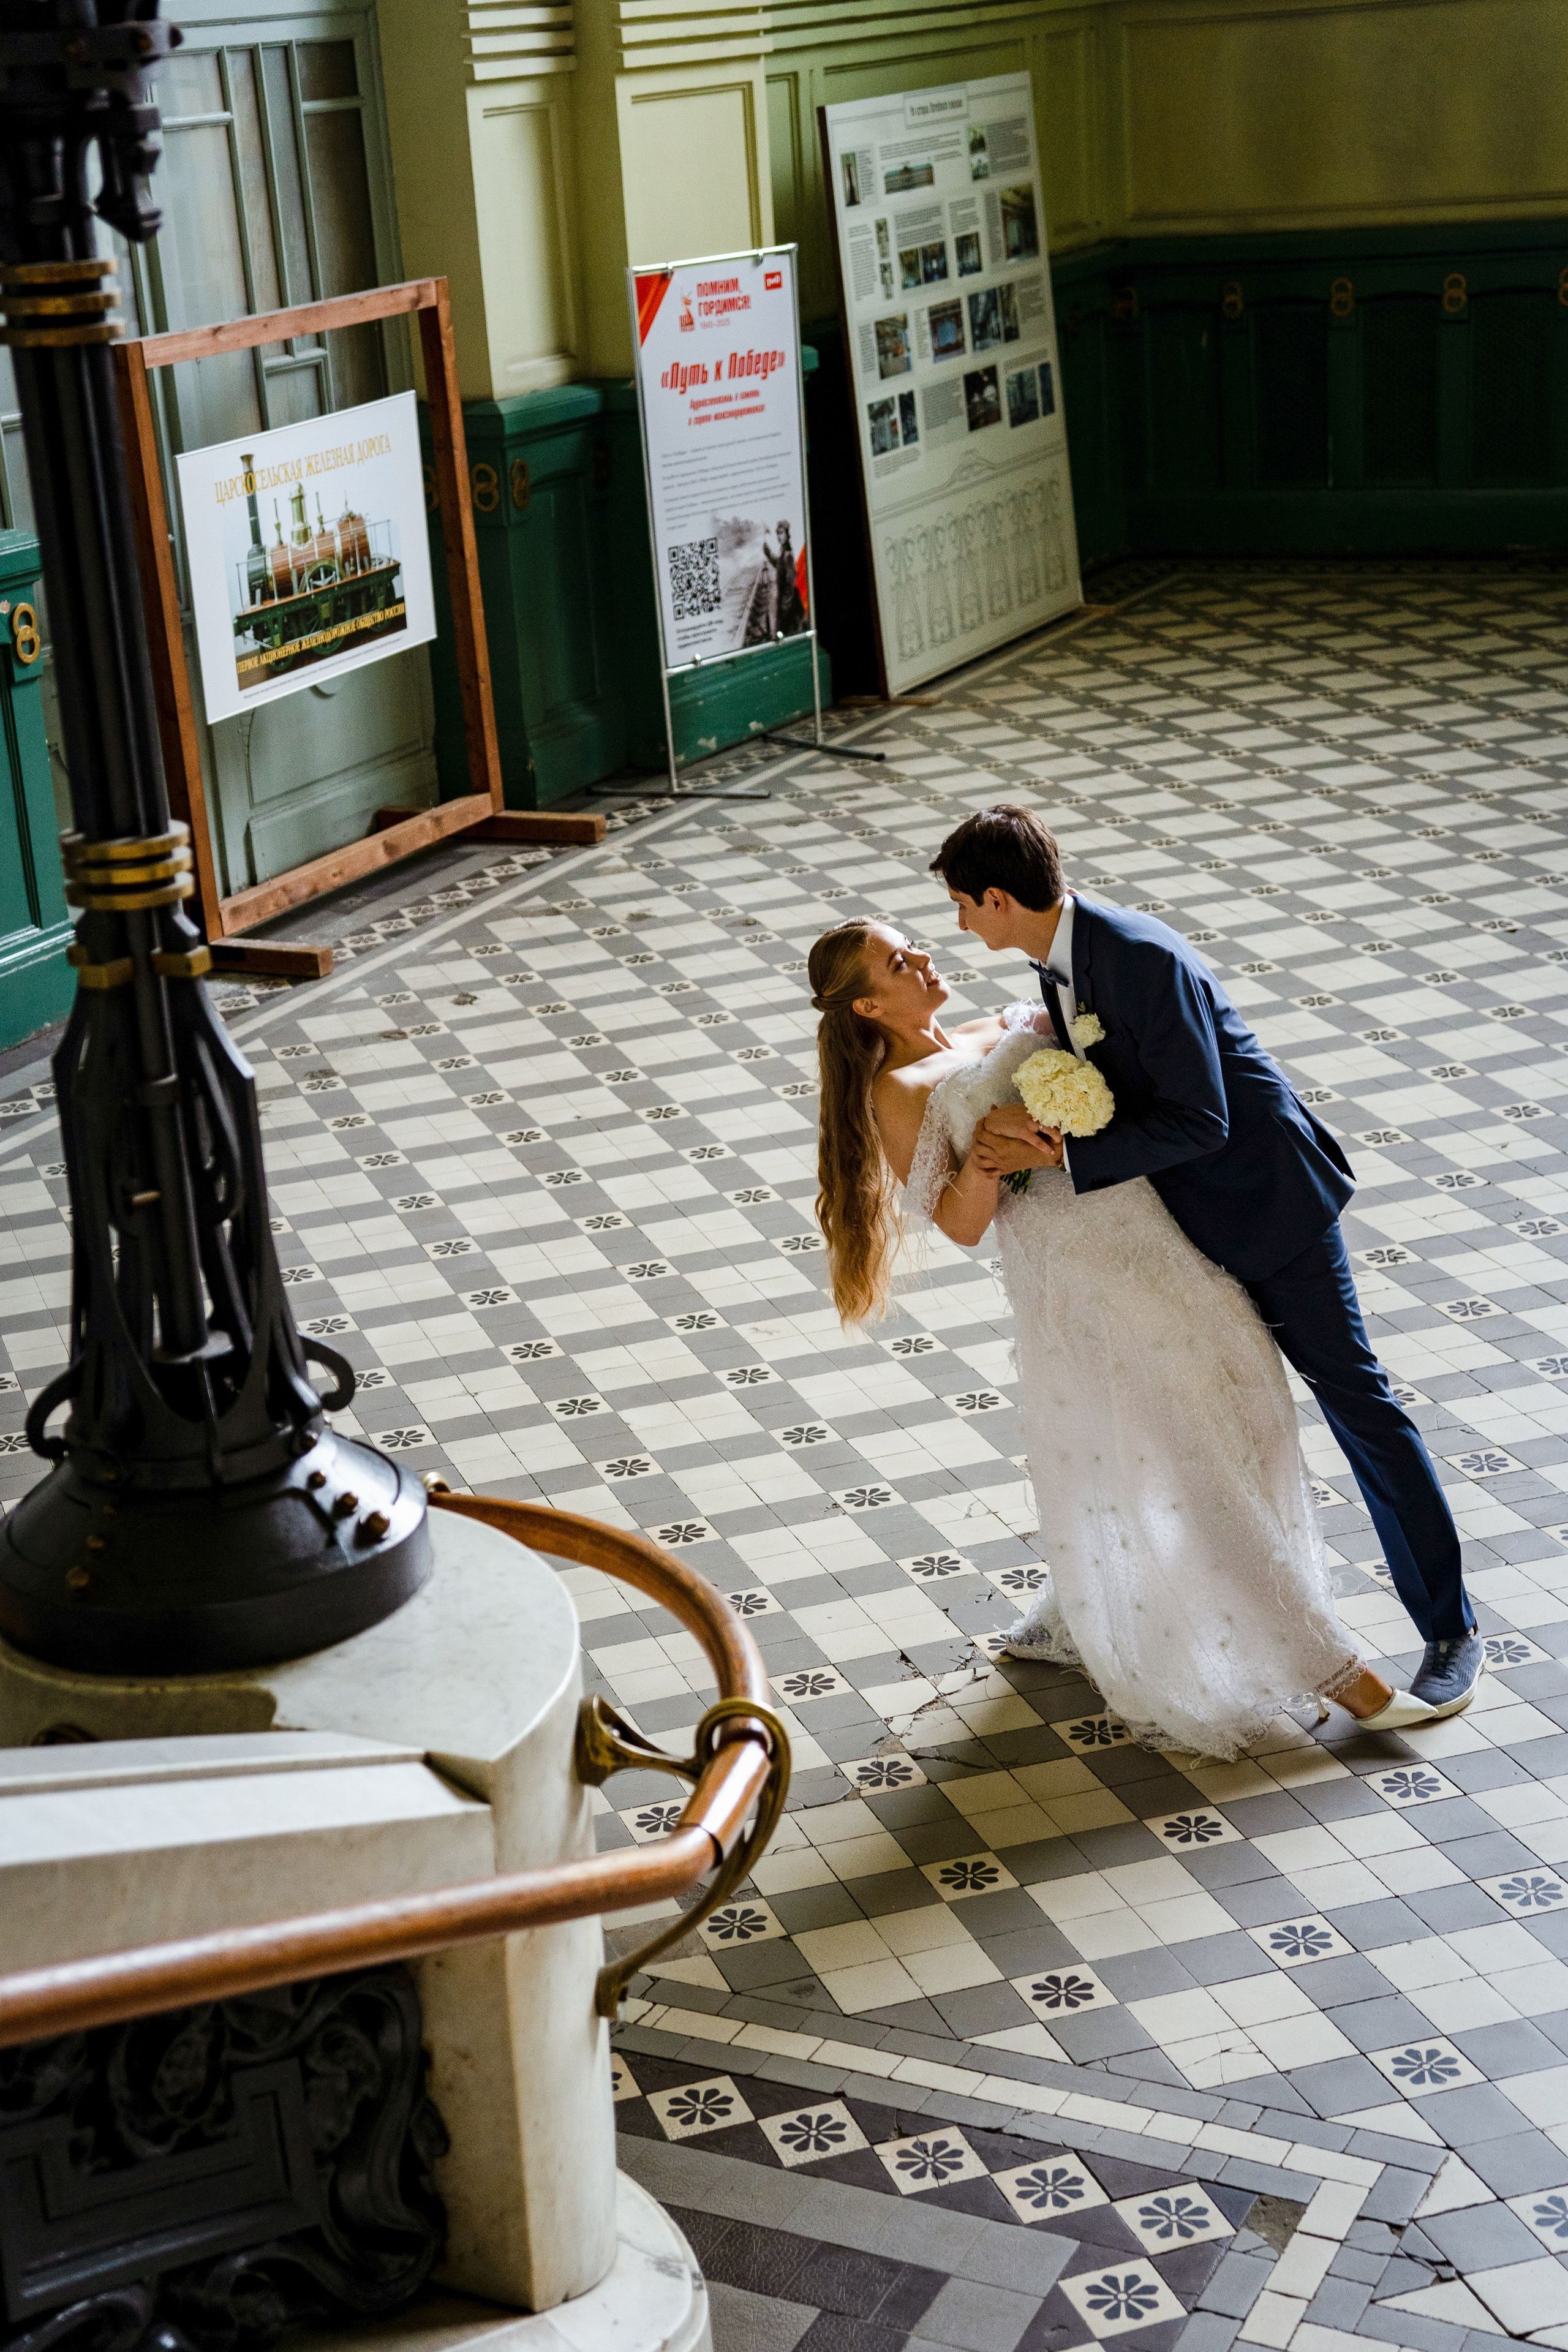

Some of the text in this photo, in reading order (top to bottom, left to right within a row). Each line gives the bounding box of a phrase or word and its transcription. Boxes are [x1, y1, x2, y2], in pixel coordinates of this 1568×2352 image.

[661, 361, 709, 395] «Путь
[728, 349, 786, 380] Победе»
[214, 433, 391, 505] ЦАРСКОСЕЛЬСКАЯ ЖЕЛЕЗНАЯ ДОРОГА
[237, 657, 258, 673] ПЕРВОЕ
[260, 641, 301, 665] АКЦИОНЕРНОЕ
[301, 621, 356, 652] ЖЕЛЕЗНОДОРОЖНОЕ
[356, 609, 385, 630] ОБЩЕСТВО
[385, 603, 405, 619] РОССИИ
